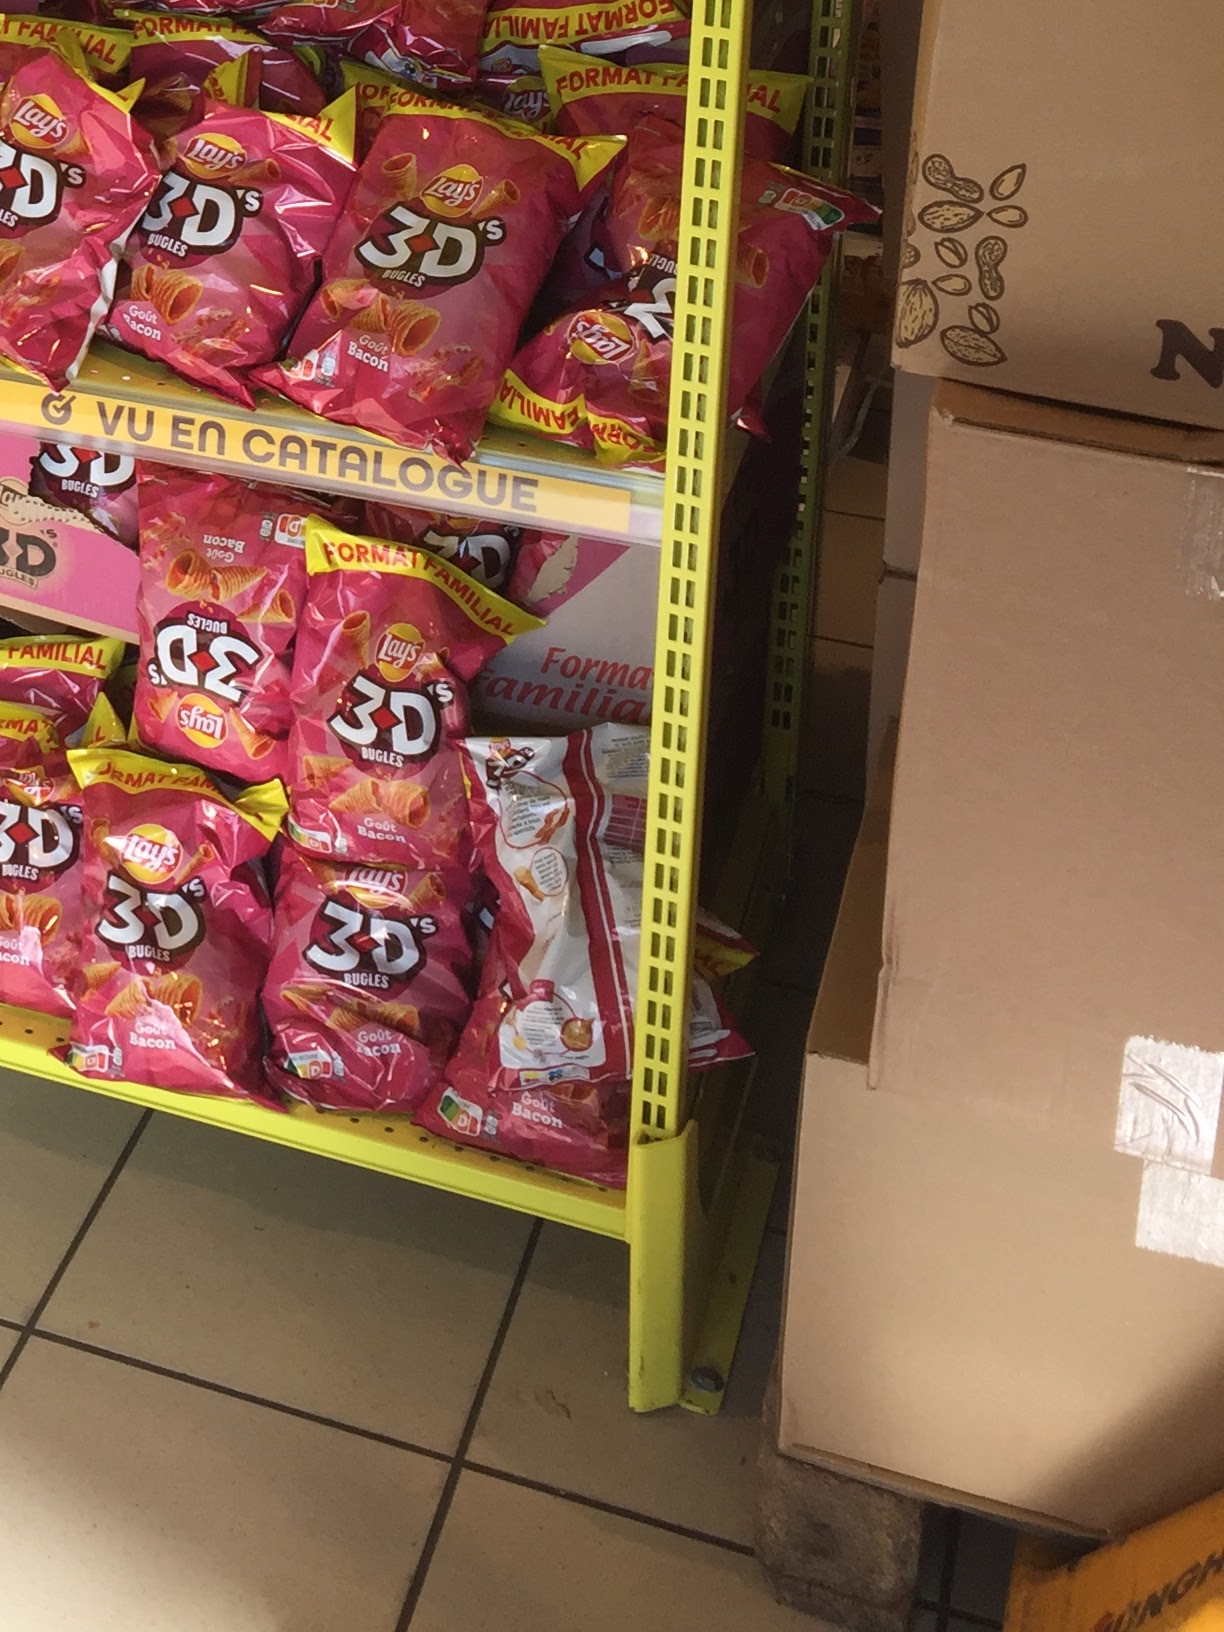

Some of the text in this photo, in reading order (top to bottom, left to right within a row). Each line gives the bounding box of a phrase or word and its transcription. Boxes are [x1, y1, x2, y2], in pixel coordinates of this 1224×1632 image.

[556, 69, 653, 92] FORMAT
[16, 97, 66, 142] Lay's
[189, 143, 245, 169] Lay's
[429, 178, 481, 203] Lay's
[148, 233, 187, 256] BUGLES
[383, 270, 425, 287] BUGLES
[129, 306, 157, 325] Goût
[349, 341, 389, 371] Bacon
[97, 402, 538, 513] VU EN CATALOGUE
[62, 480, 99, 498] BUGLES
[204, 534, 244, 552] Bacon
[323, 542, 514, 636] FORMAT FAMILIAL
[187, 612, 227, 633] BUGLES
[8, 644, 106, 672] FAMILIAL
[380, 636, 422, 663] Lay's
[541, 647, 653, 691] Forma
[178, 709, 225, 736] Lay's
[362, 748, 404, 767] BUGLES
[357, 829, 406, 844] Bacon
[128, 837, 179, 868] Lay's
[2, 866, 39, 880] BUGLES
[128, 944, 170, 962] BUGLES
[344, 972, 390, 989] BUGLES
[128, 1032, 176, 1050] Bacon
[512, 1100, 564, 1129] Bacon
